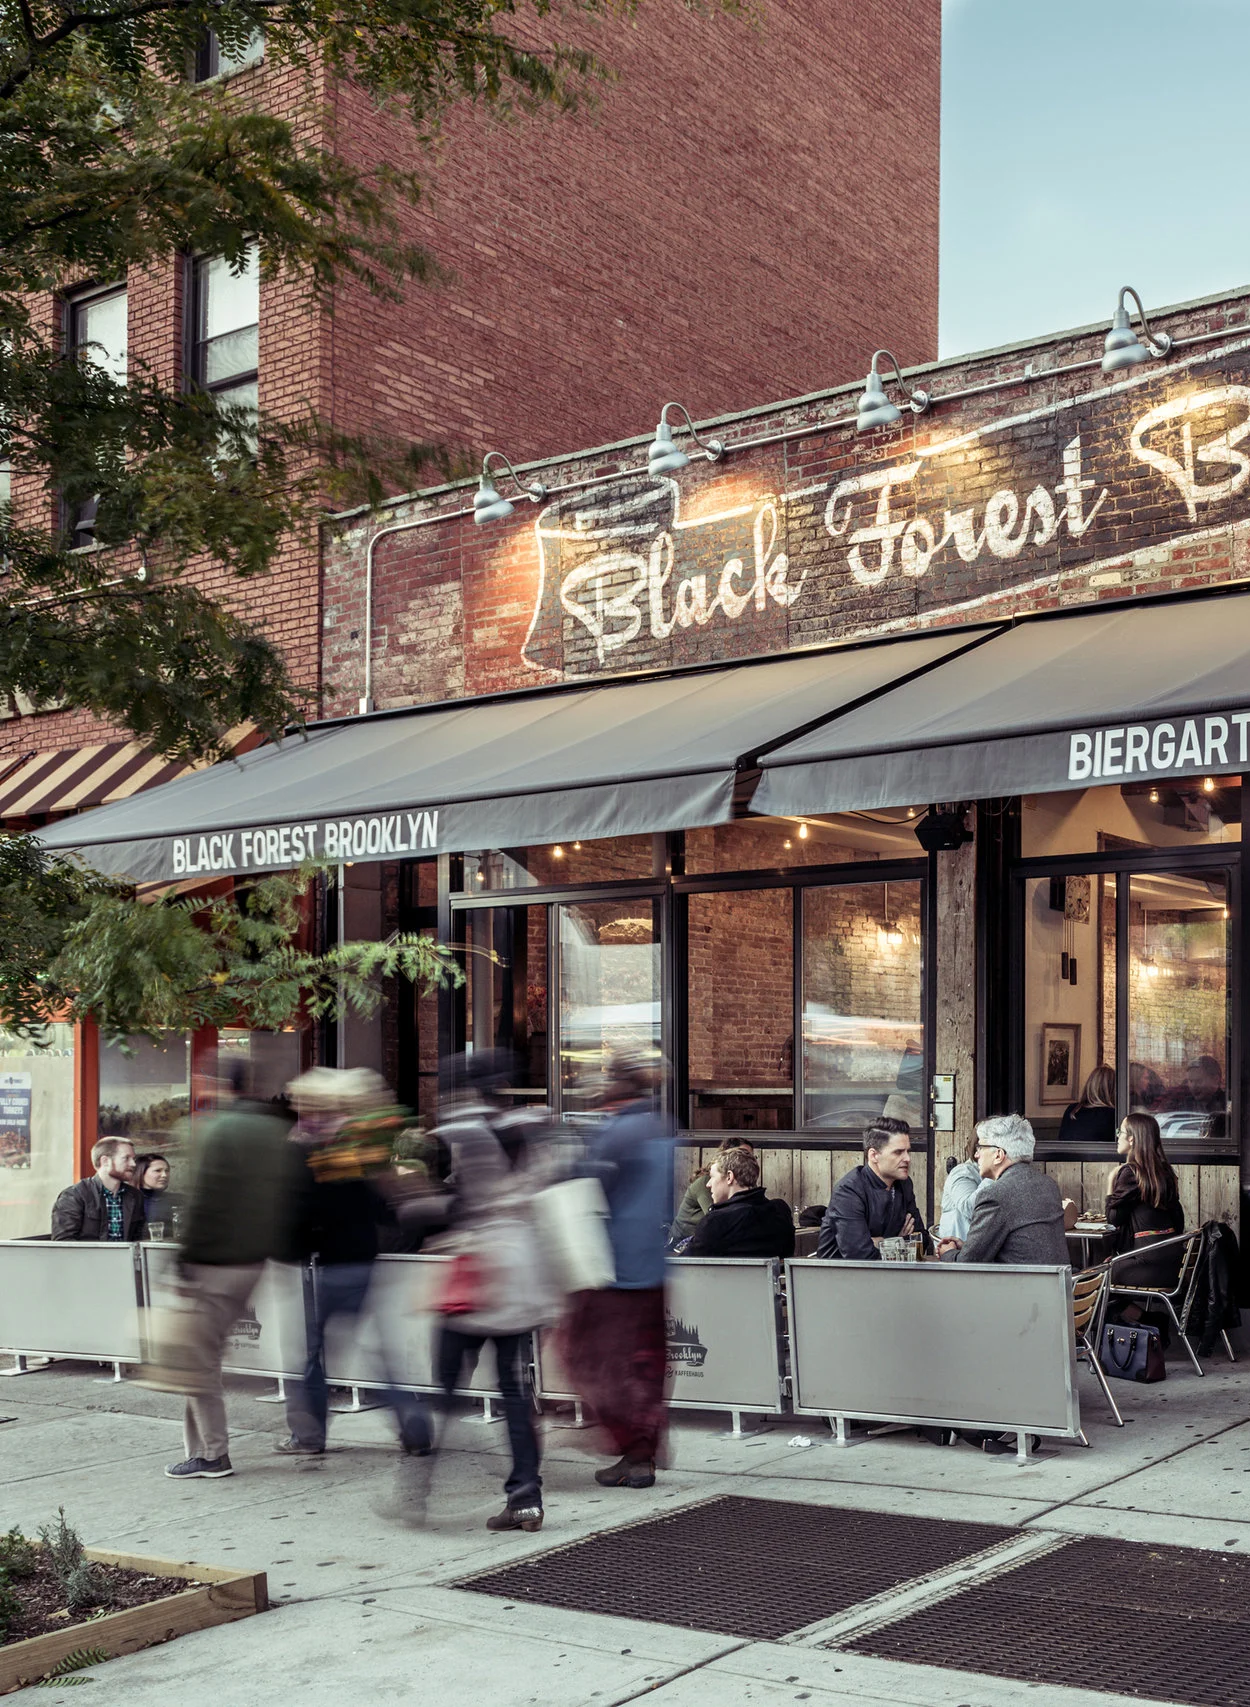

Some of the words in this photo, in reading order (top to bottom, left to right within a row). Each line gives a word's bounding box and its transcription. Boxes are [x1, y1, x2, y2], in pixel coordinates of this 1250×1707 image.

[561, 497, 808, 664] Black
[824, 434, 1108, 586] Forest
[173, 833, 237, 874] BLACK
[241, 824, 318, 868] FOREST
[324, 811, 439, 858] BROOKLYN
